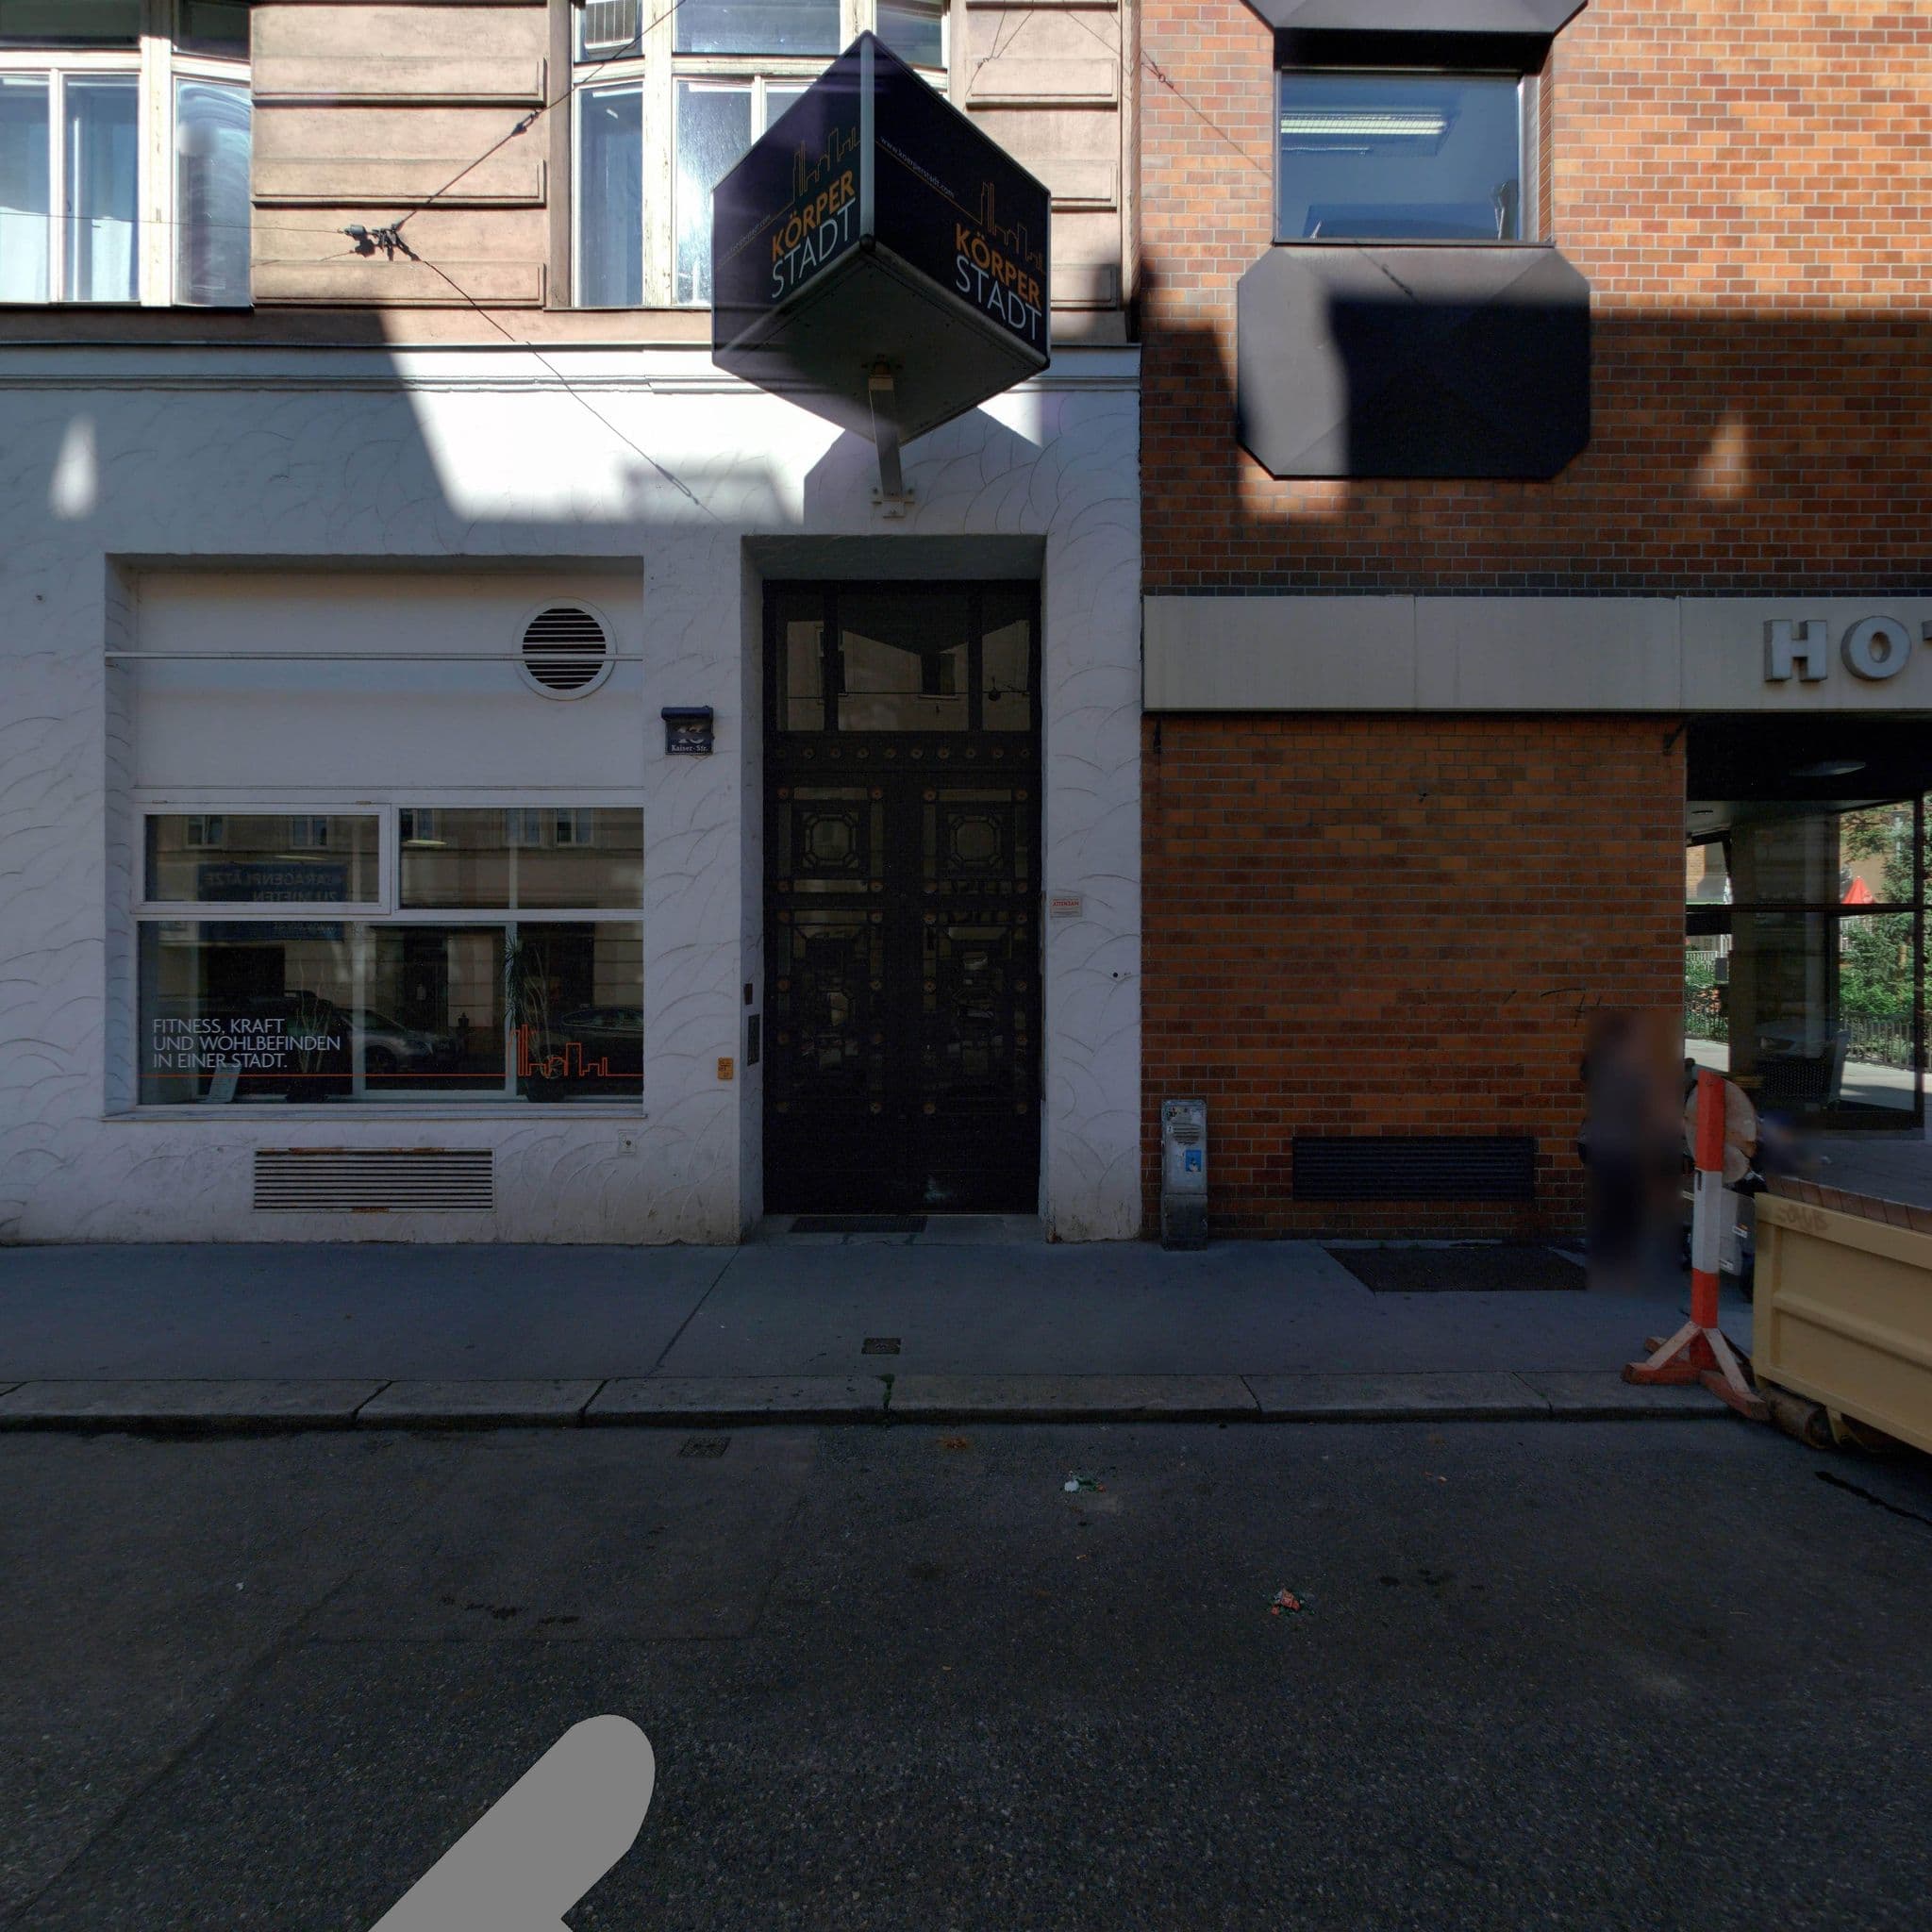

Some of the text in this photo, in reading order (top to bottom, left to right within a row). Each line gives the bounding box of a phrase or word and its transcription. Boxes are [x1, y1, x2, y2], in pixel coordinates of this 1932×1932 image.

[771, 170, 855, 262] KÖRPER
[771, 196, 856, 299] STADT
[956, 223, 1041, 310] KÖRPER
[956, 255, 1041, 340] STADT
[1764, 615, 1932, 682] HO
[153, 1018, 285, 1035] FITNESS, KRAFT
[153, 1036, 341, 1051] UND WOHLBEFINDEN
[153, 1053, 287, 1068] IN EINER STADT.
